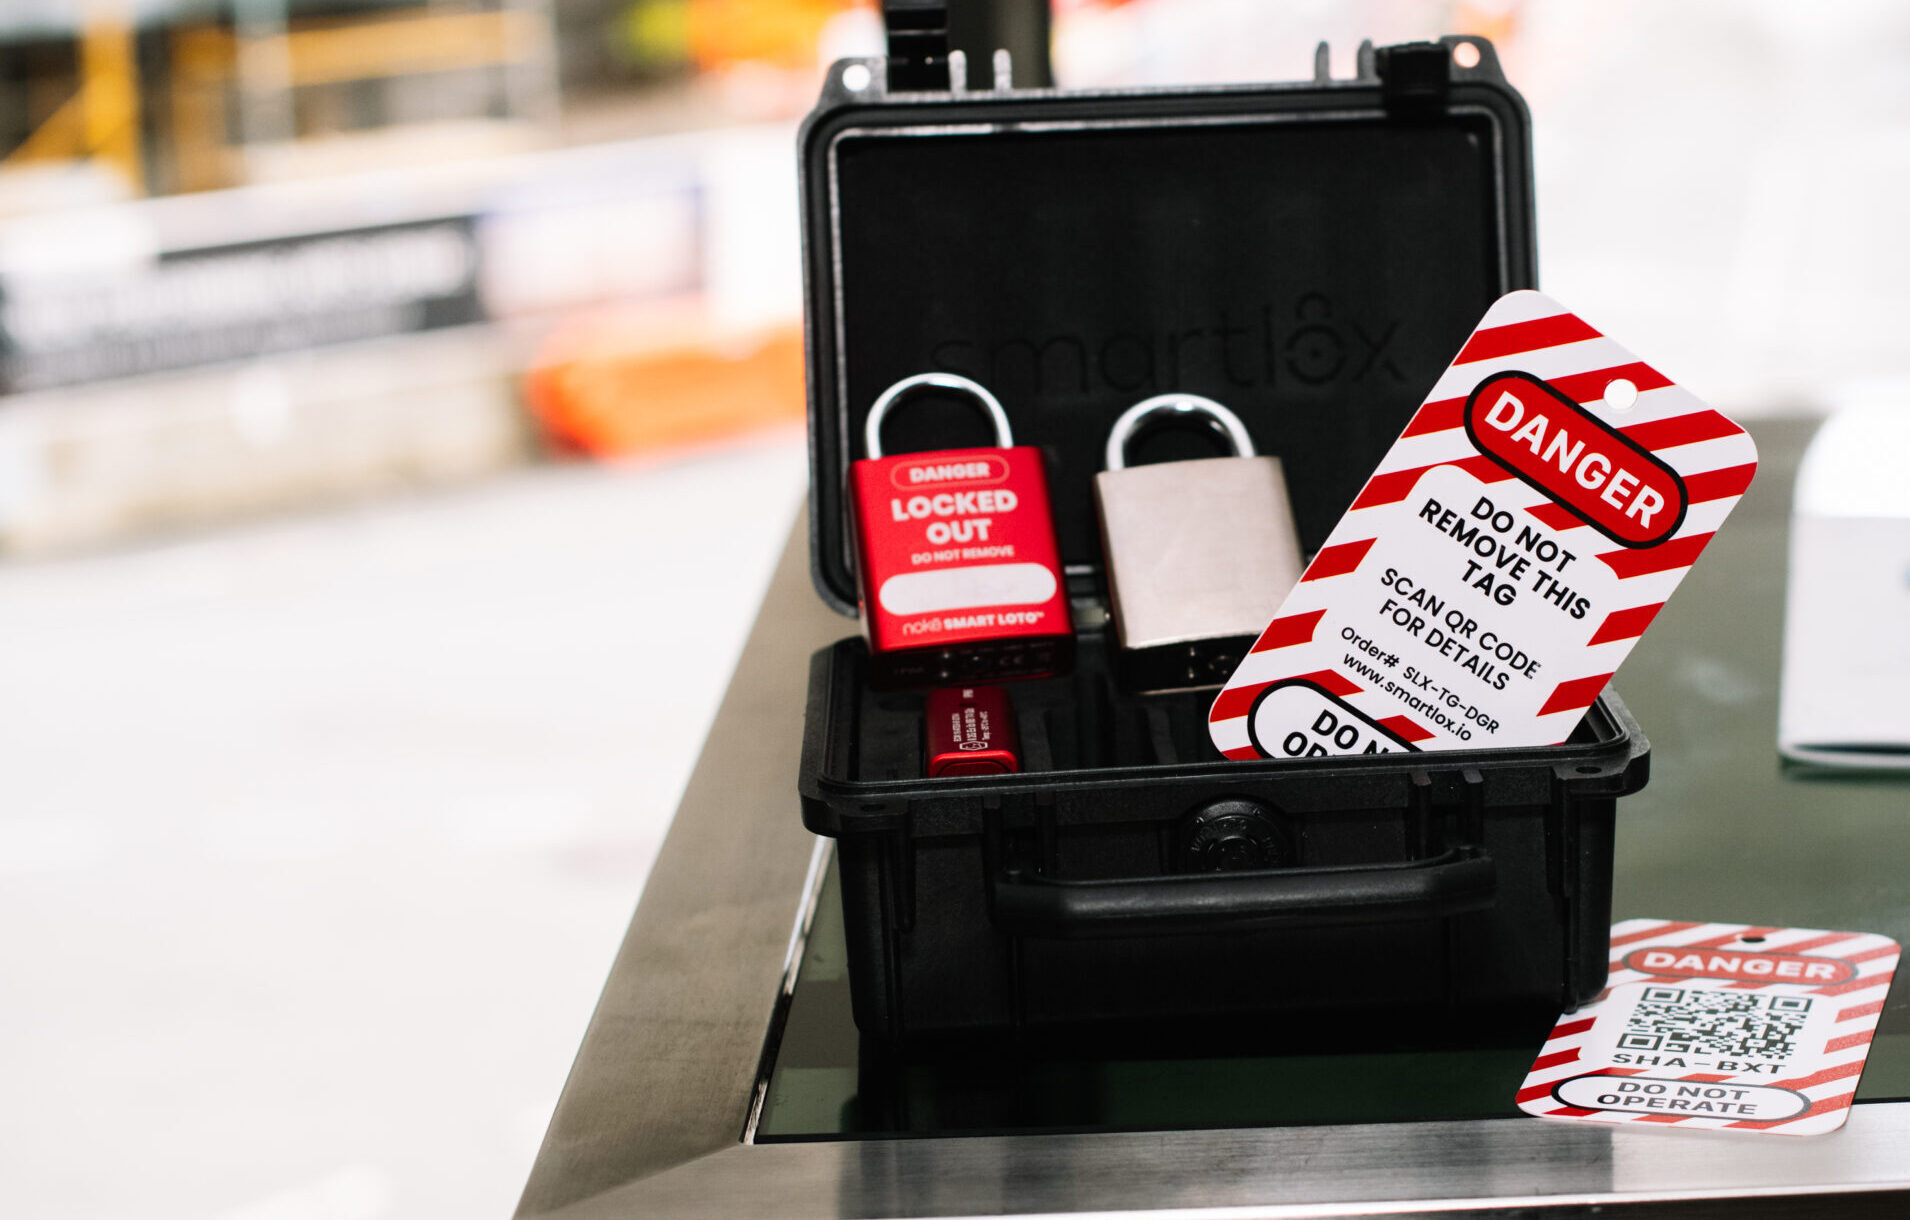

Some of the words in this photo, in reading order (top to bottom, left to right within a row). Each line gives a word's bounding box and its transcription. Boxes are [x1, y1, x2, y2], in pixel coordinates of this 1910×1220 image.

[908, 461, 990, 483] DANGER
[1484, 390, 1666, 529] DANGER
[891, 489, 1019, 521] LOCKED
[926, 518, 992, 545] OUT
[1470, 496, 1515, 534] DO
[1514, 525, 1577, 573] NOT
[911, 552, 933, 566] DO
[934, 549, 960, 563] NOT
[962, 545, 1014, 559] REMOVE
[1418, 497, 1532, 582] REMOVE
[1531, 569, 1591, 620] THIS
[1461, 559, 1517, 606] TAG
[943, 614, 994, 630] SMART
[1380, 567, 1446, 618] SCAN
[1444, 609, 1478, 640] QR
[1479, 631, 1543, 680] CODE
[1379, 598, 1426, 638] FOR
[1424, 627, 1511, 691] DETAILS
[1341, 626, 1400, 668] Order#
[1402, 666, 1500, 735] SLX-TG-DGR
[1343, 653, 1472, 741] www.smartlox.io
[1311, 708, 1360, 750] DO
[1643, 951, 1836, 979] DANGER
[1611, 1053, 1787, 1075] SHA-BXT
[1596, 1093, 1759, 1115] OPERATE
[1617, 1082, 1667, 1095] DO
[1677, 1086, 1750, 1100] NOT
